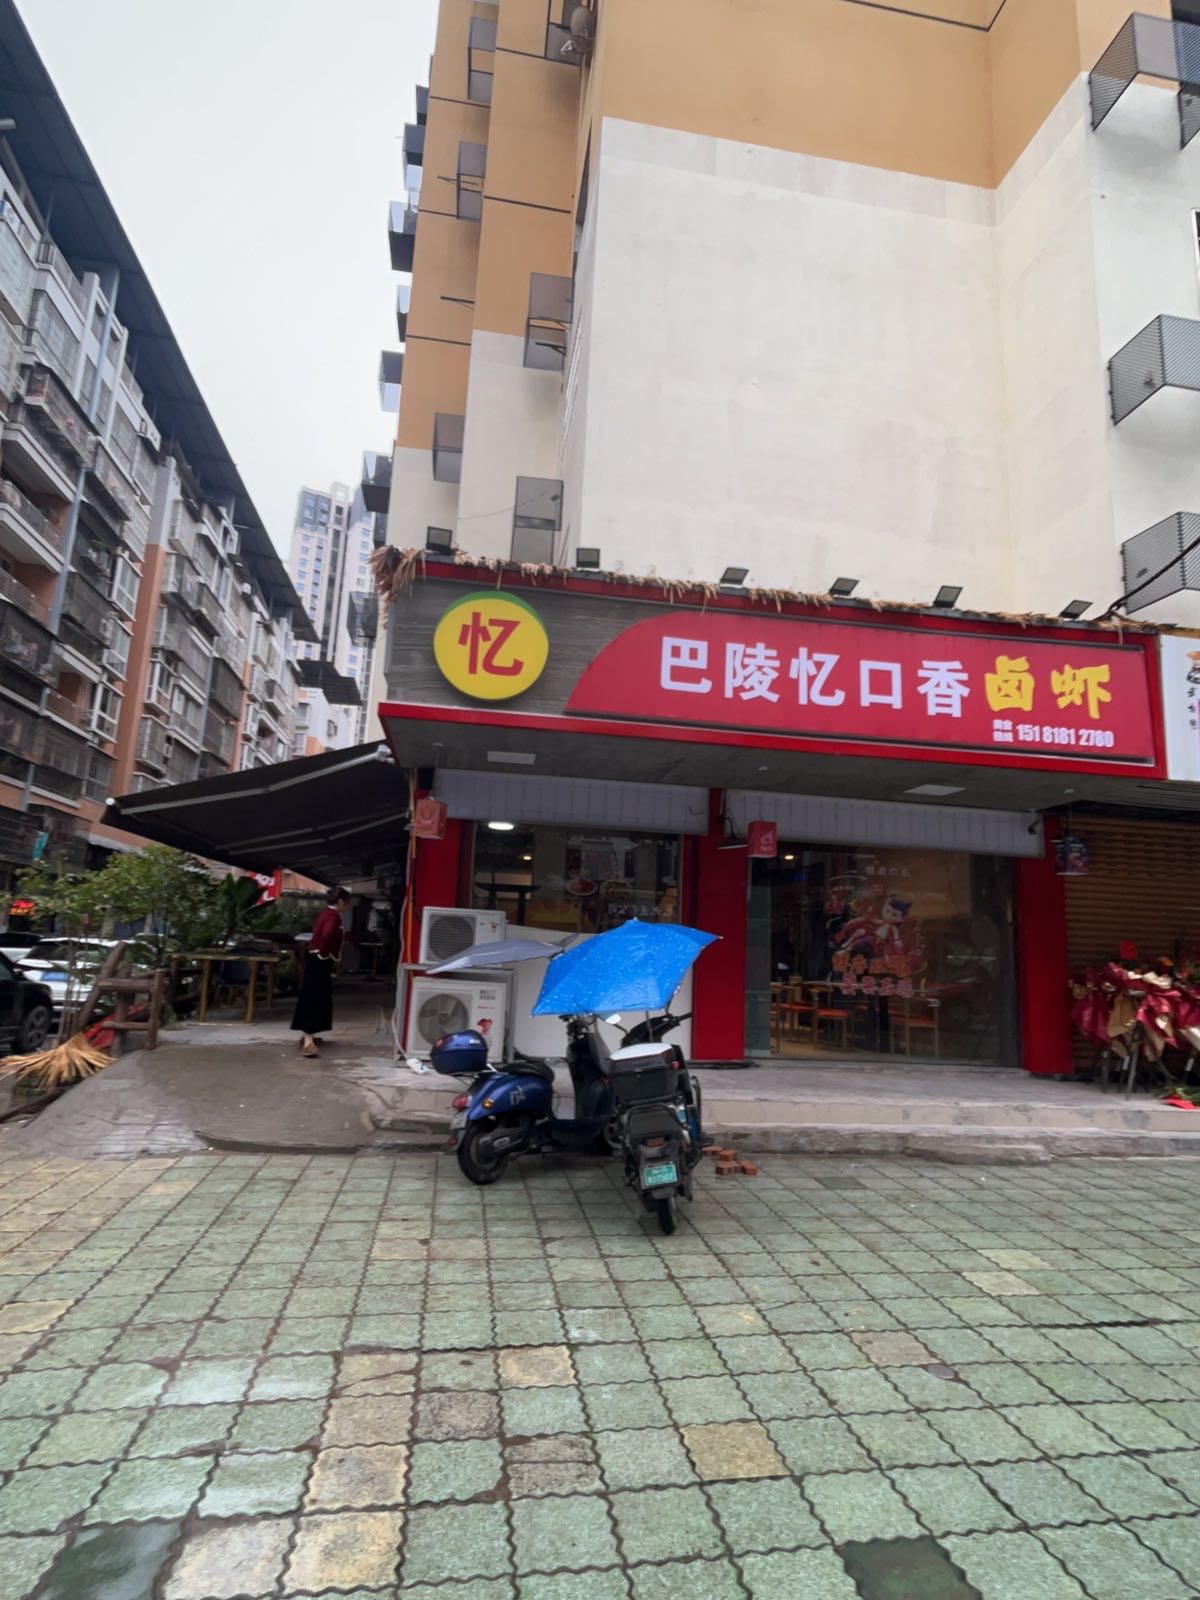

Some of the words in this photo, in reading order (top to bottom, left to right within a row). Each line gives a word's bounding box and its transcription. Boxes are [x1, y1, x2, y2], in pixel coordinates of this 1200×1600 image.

[458, 611, 525, 677] 忆
[1015, 724, 1041, 742] 151
[1042, 726, 1076, 745] 8181
[1078, 728, 1114, 748] 2780
